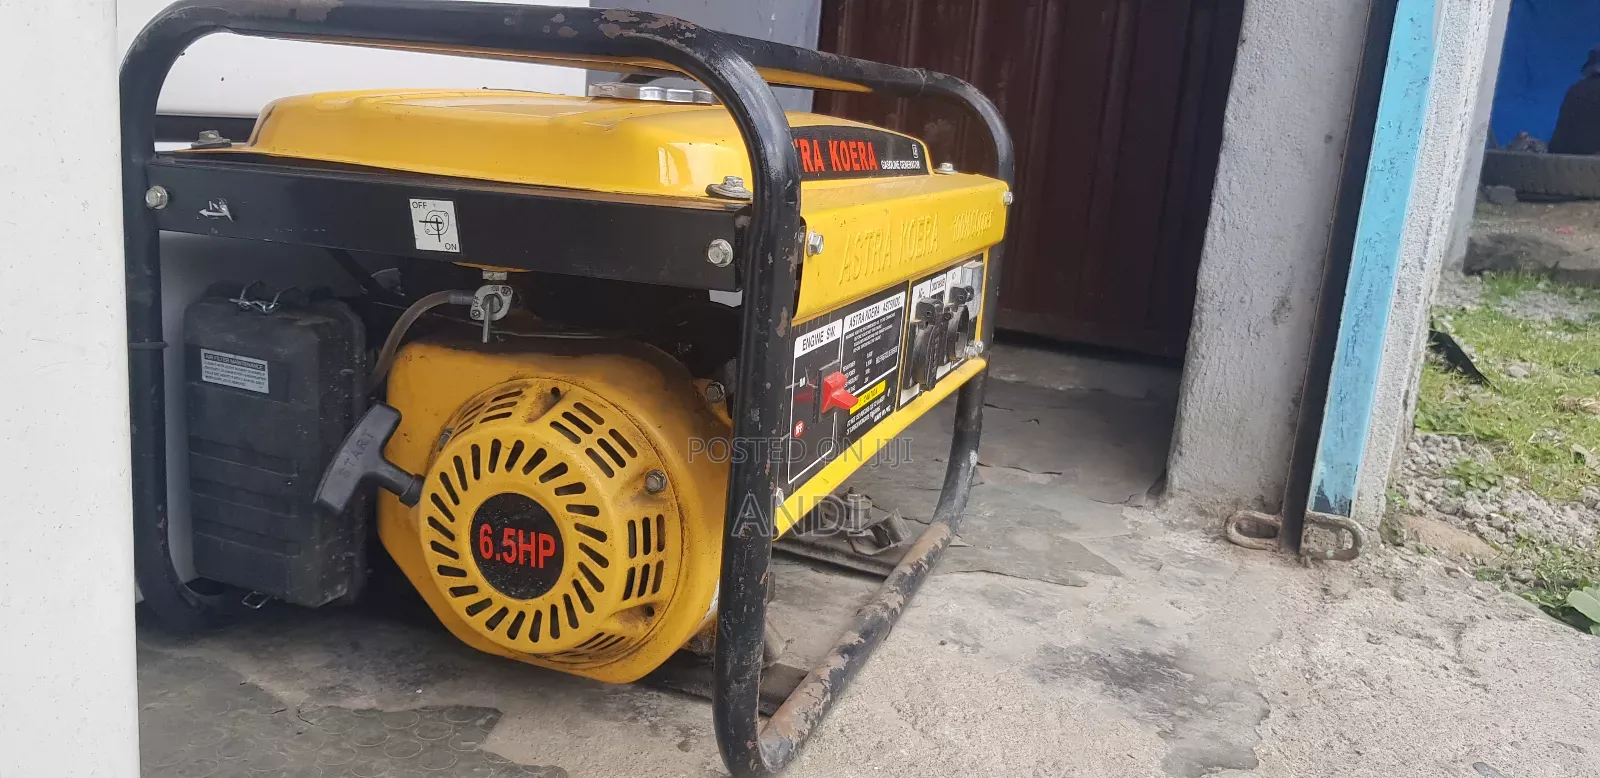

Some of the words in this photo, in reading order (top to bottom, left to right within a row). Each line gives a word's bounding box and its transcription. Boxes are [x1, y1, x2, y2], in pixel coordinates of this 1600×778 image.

[794, 139, 825, 172] RA
[829, 140, 879, 171] KOERA
[411, 201, 428, 209] OFF
[444, 242, 457, 251] ON
[838, 226, 892, 285] ASTRA
[898, 212, 939, 265] KOERA
[848, 312, 865, 329] ASTRA
[802, 330, 824, 352] ENGINE
[339, 429, 376, 479] START
[479, 523, 556, 569] 6.5HP
